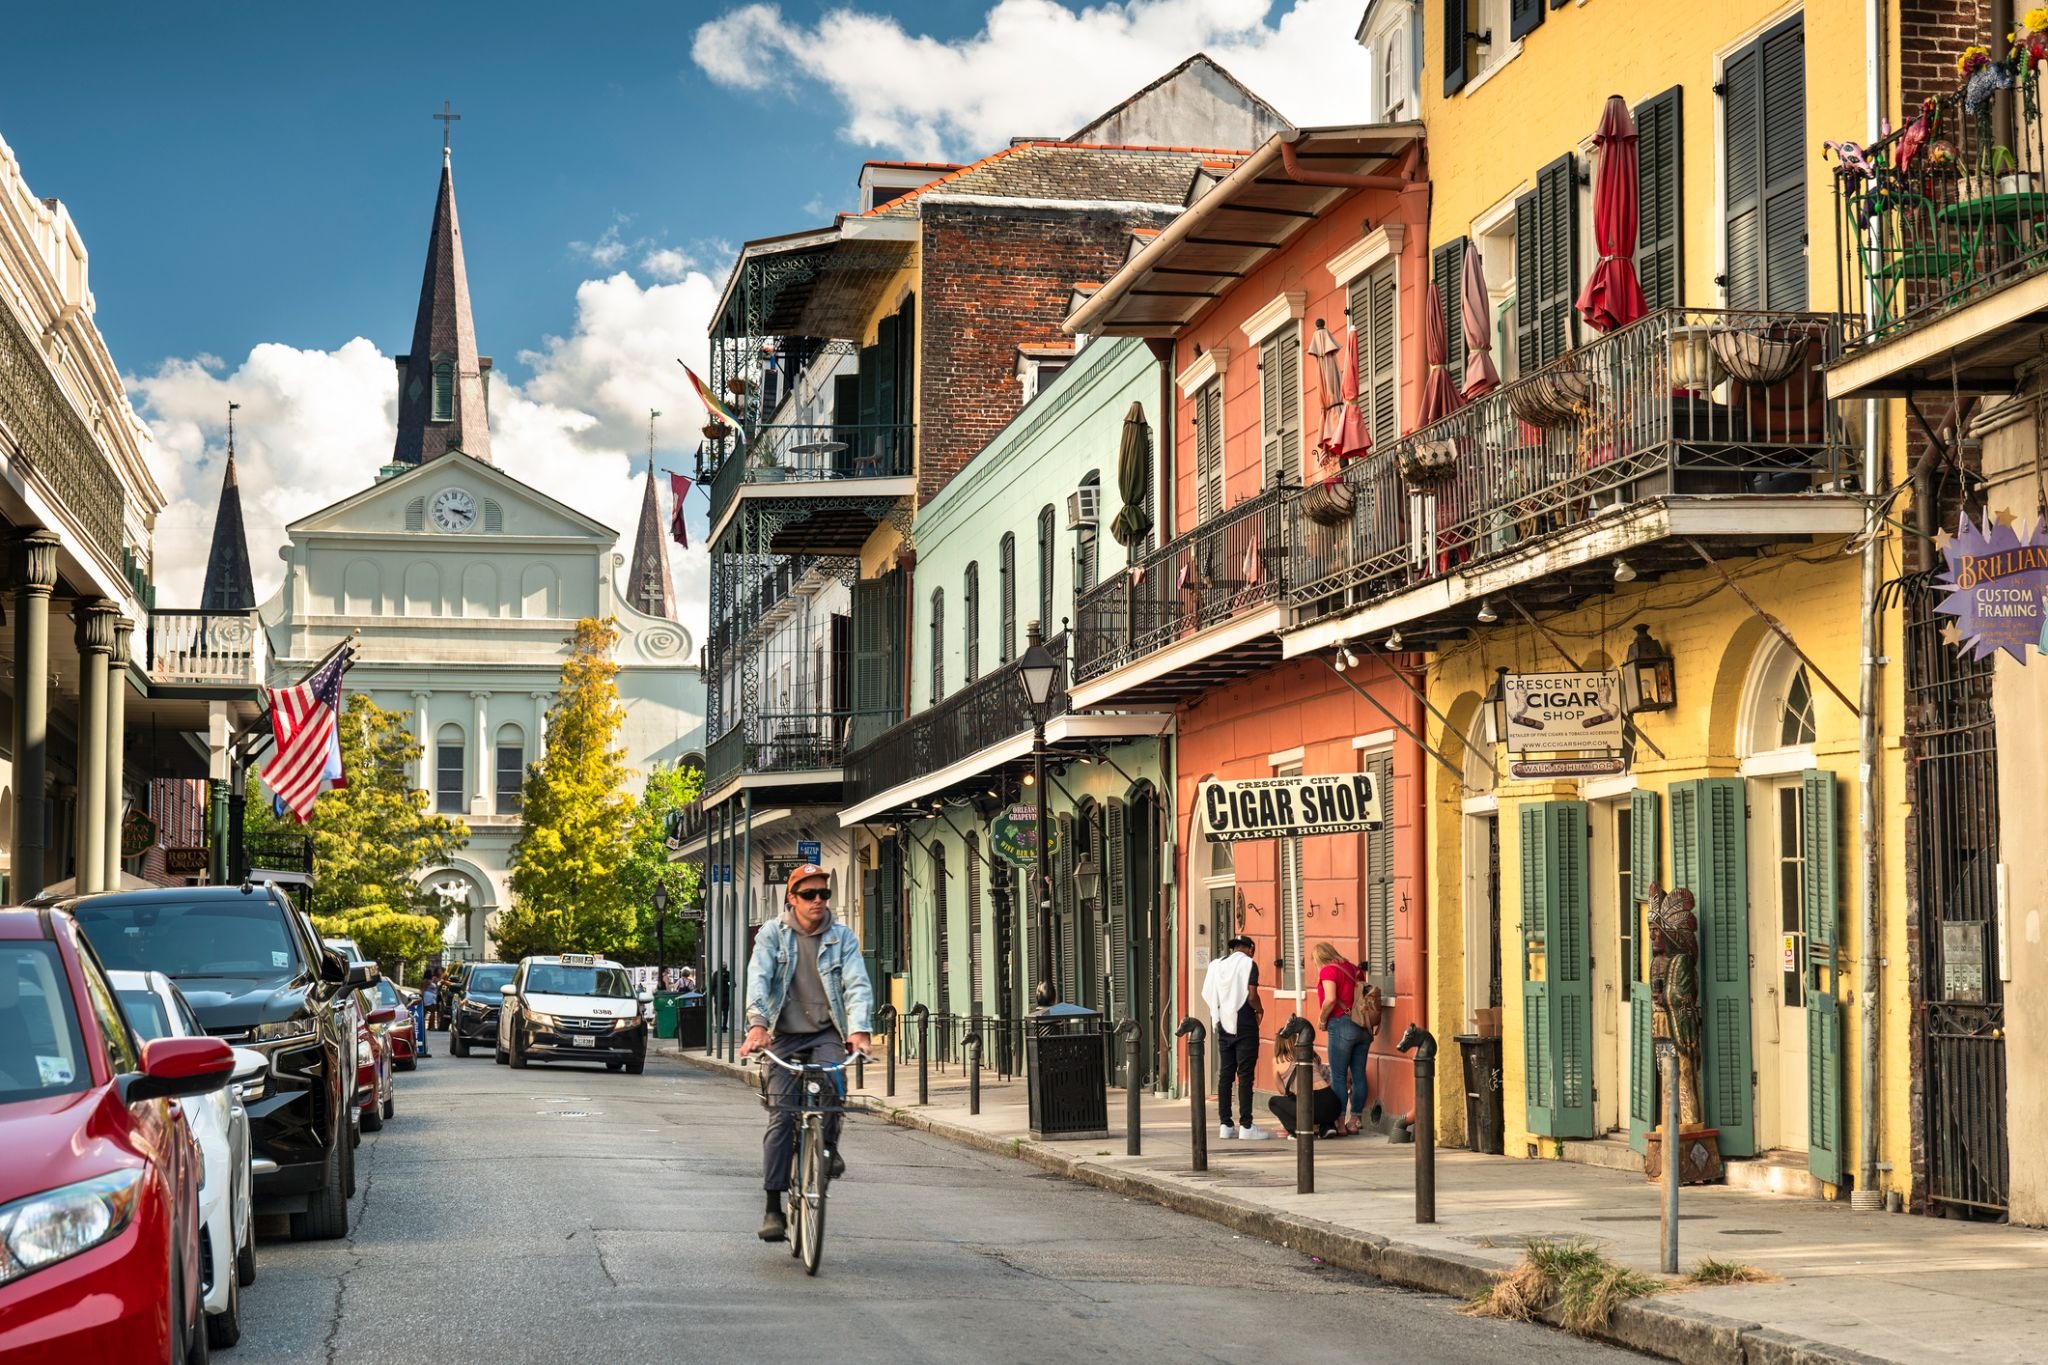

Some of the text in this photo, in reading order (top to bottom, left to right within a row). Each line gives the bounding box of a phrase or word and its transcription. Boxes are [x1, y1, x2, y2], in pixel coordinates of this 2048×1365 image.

[1976, 588, 2033, 602] CUSTOM
[1977, 603, 2037, 617] FRAMING
[1506, 677, 1617, 690] CRESCENT CITY
[1526, 692, 1599, 708] CIGAR
[1543, 710, 1585, 721] SHOP
[1522, 740, 1608, 748] WWW.CCCIGARSHOP.COM
[1566, 761, 1614, 772] HUMIDOR
[1236, 776, 1340, 790] CRESCENT CITY
[1206, 776, 1373, 831] CIGAR SHOP
[1008, 813, 1037, 821] GRAPEVI
[1217, 823, 1373, 841] WALK-IN HUMIDOR
[168, 851, 207, 860] ROUX
